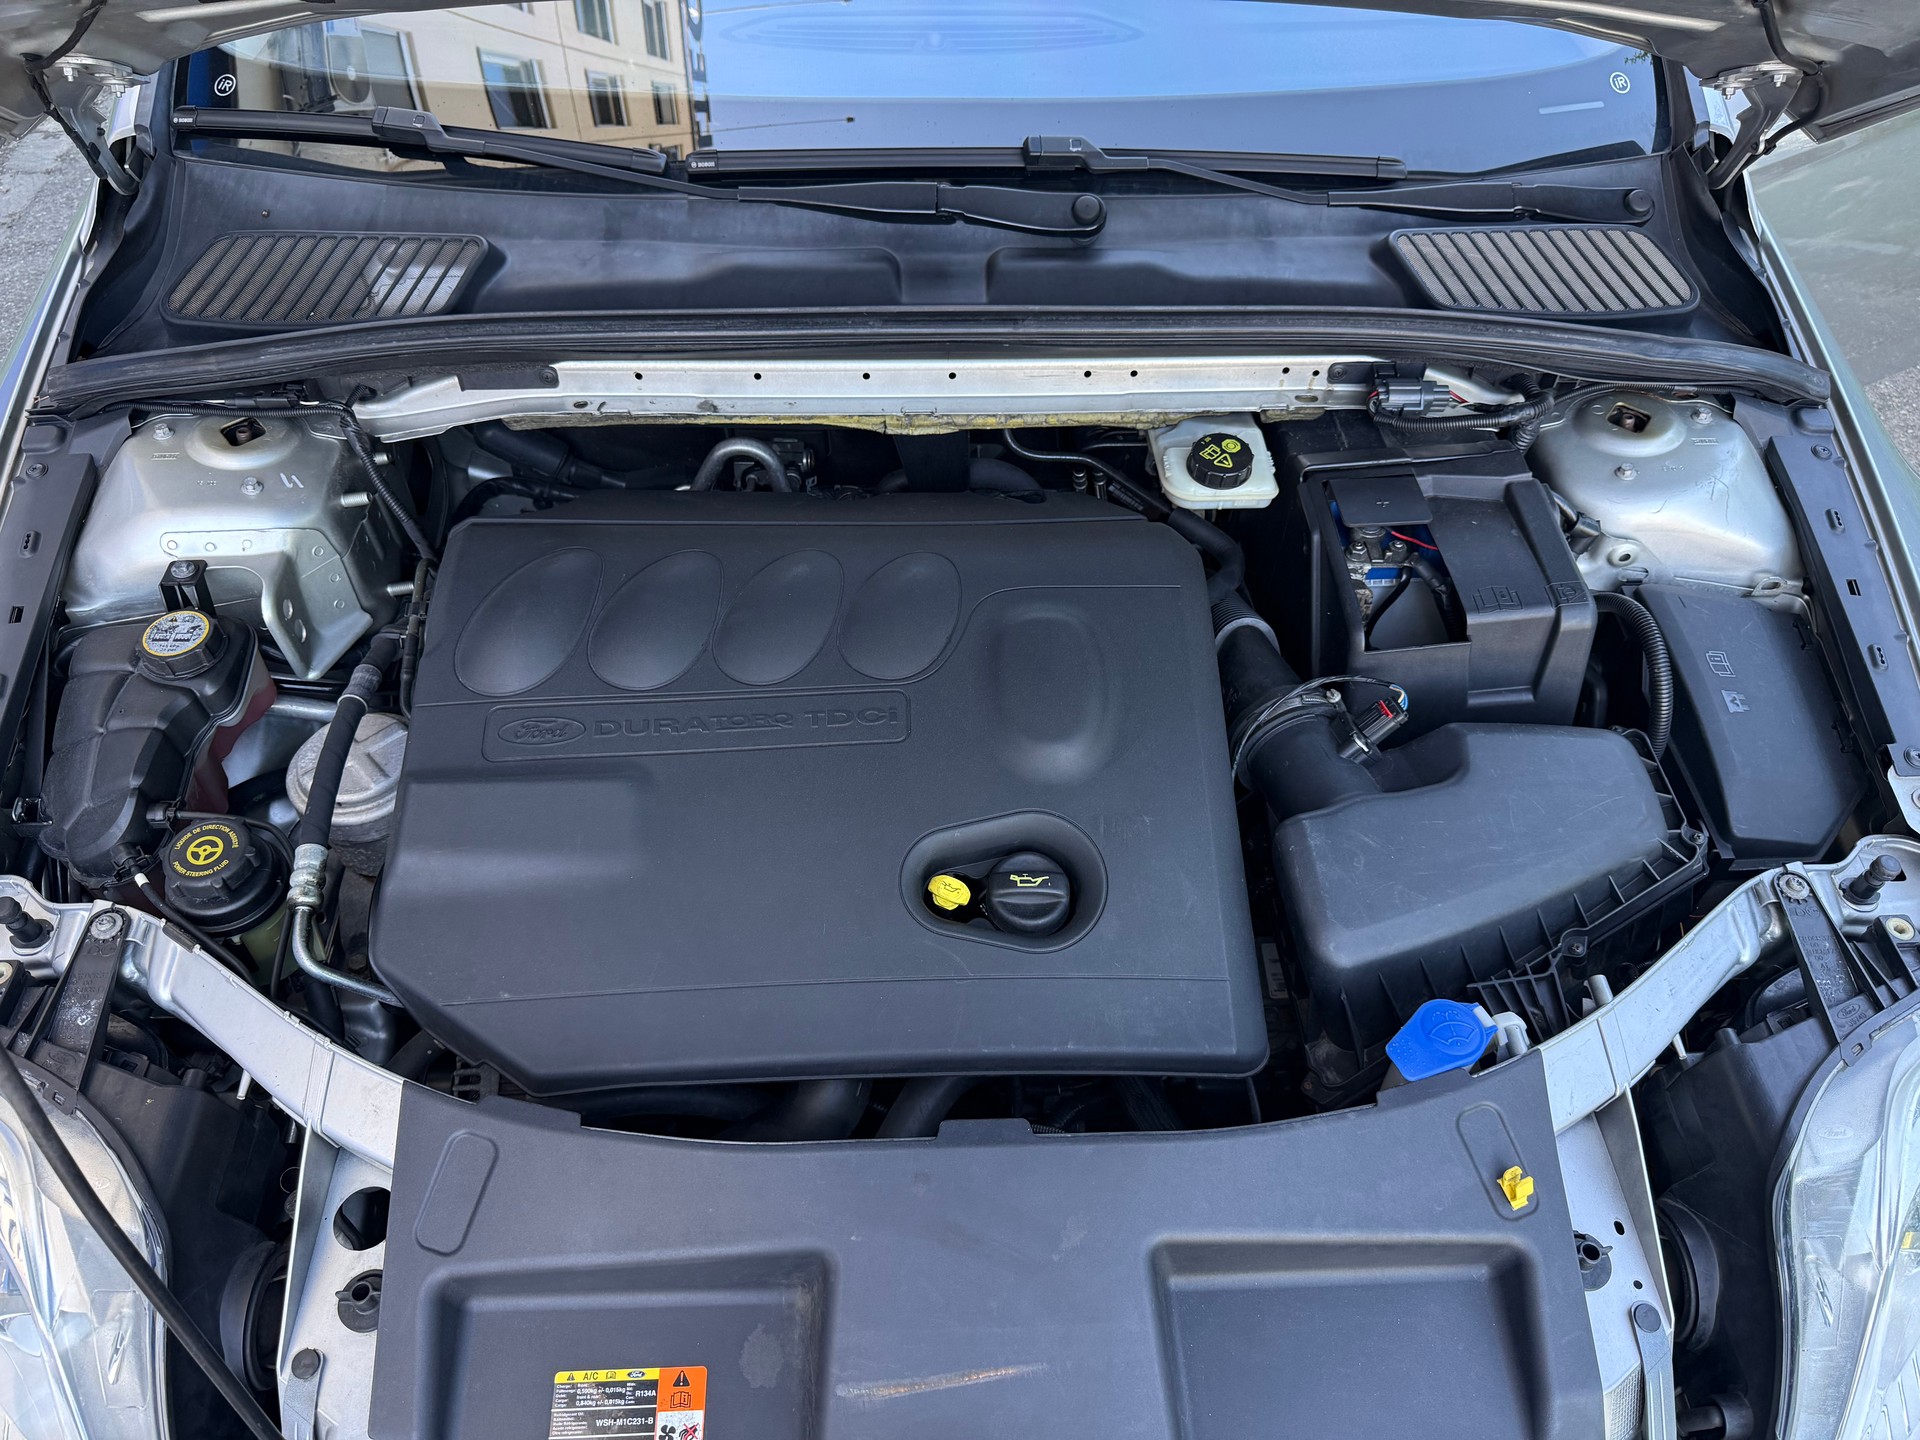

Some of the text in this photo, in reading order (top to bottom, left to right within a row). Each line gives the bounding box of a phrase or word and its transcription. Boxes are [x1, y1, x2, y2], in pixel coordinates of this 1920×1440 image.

[804, 707, 899, 729] TDCi
[174, 832, 193, 850] LIQUIDE
[192, 827, 202, 835] DE
[202, 824, 231, 834] DIRECTION
[173, 859, 230, 877] POWER STEERING FLUID
[583, 1371, 644, 1381] A/C Ford
[635, 1390, 656, 1398] R134A
[596, 1417, 654, 1427] WSH-M1C231-B
